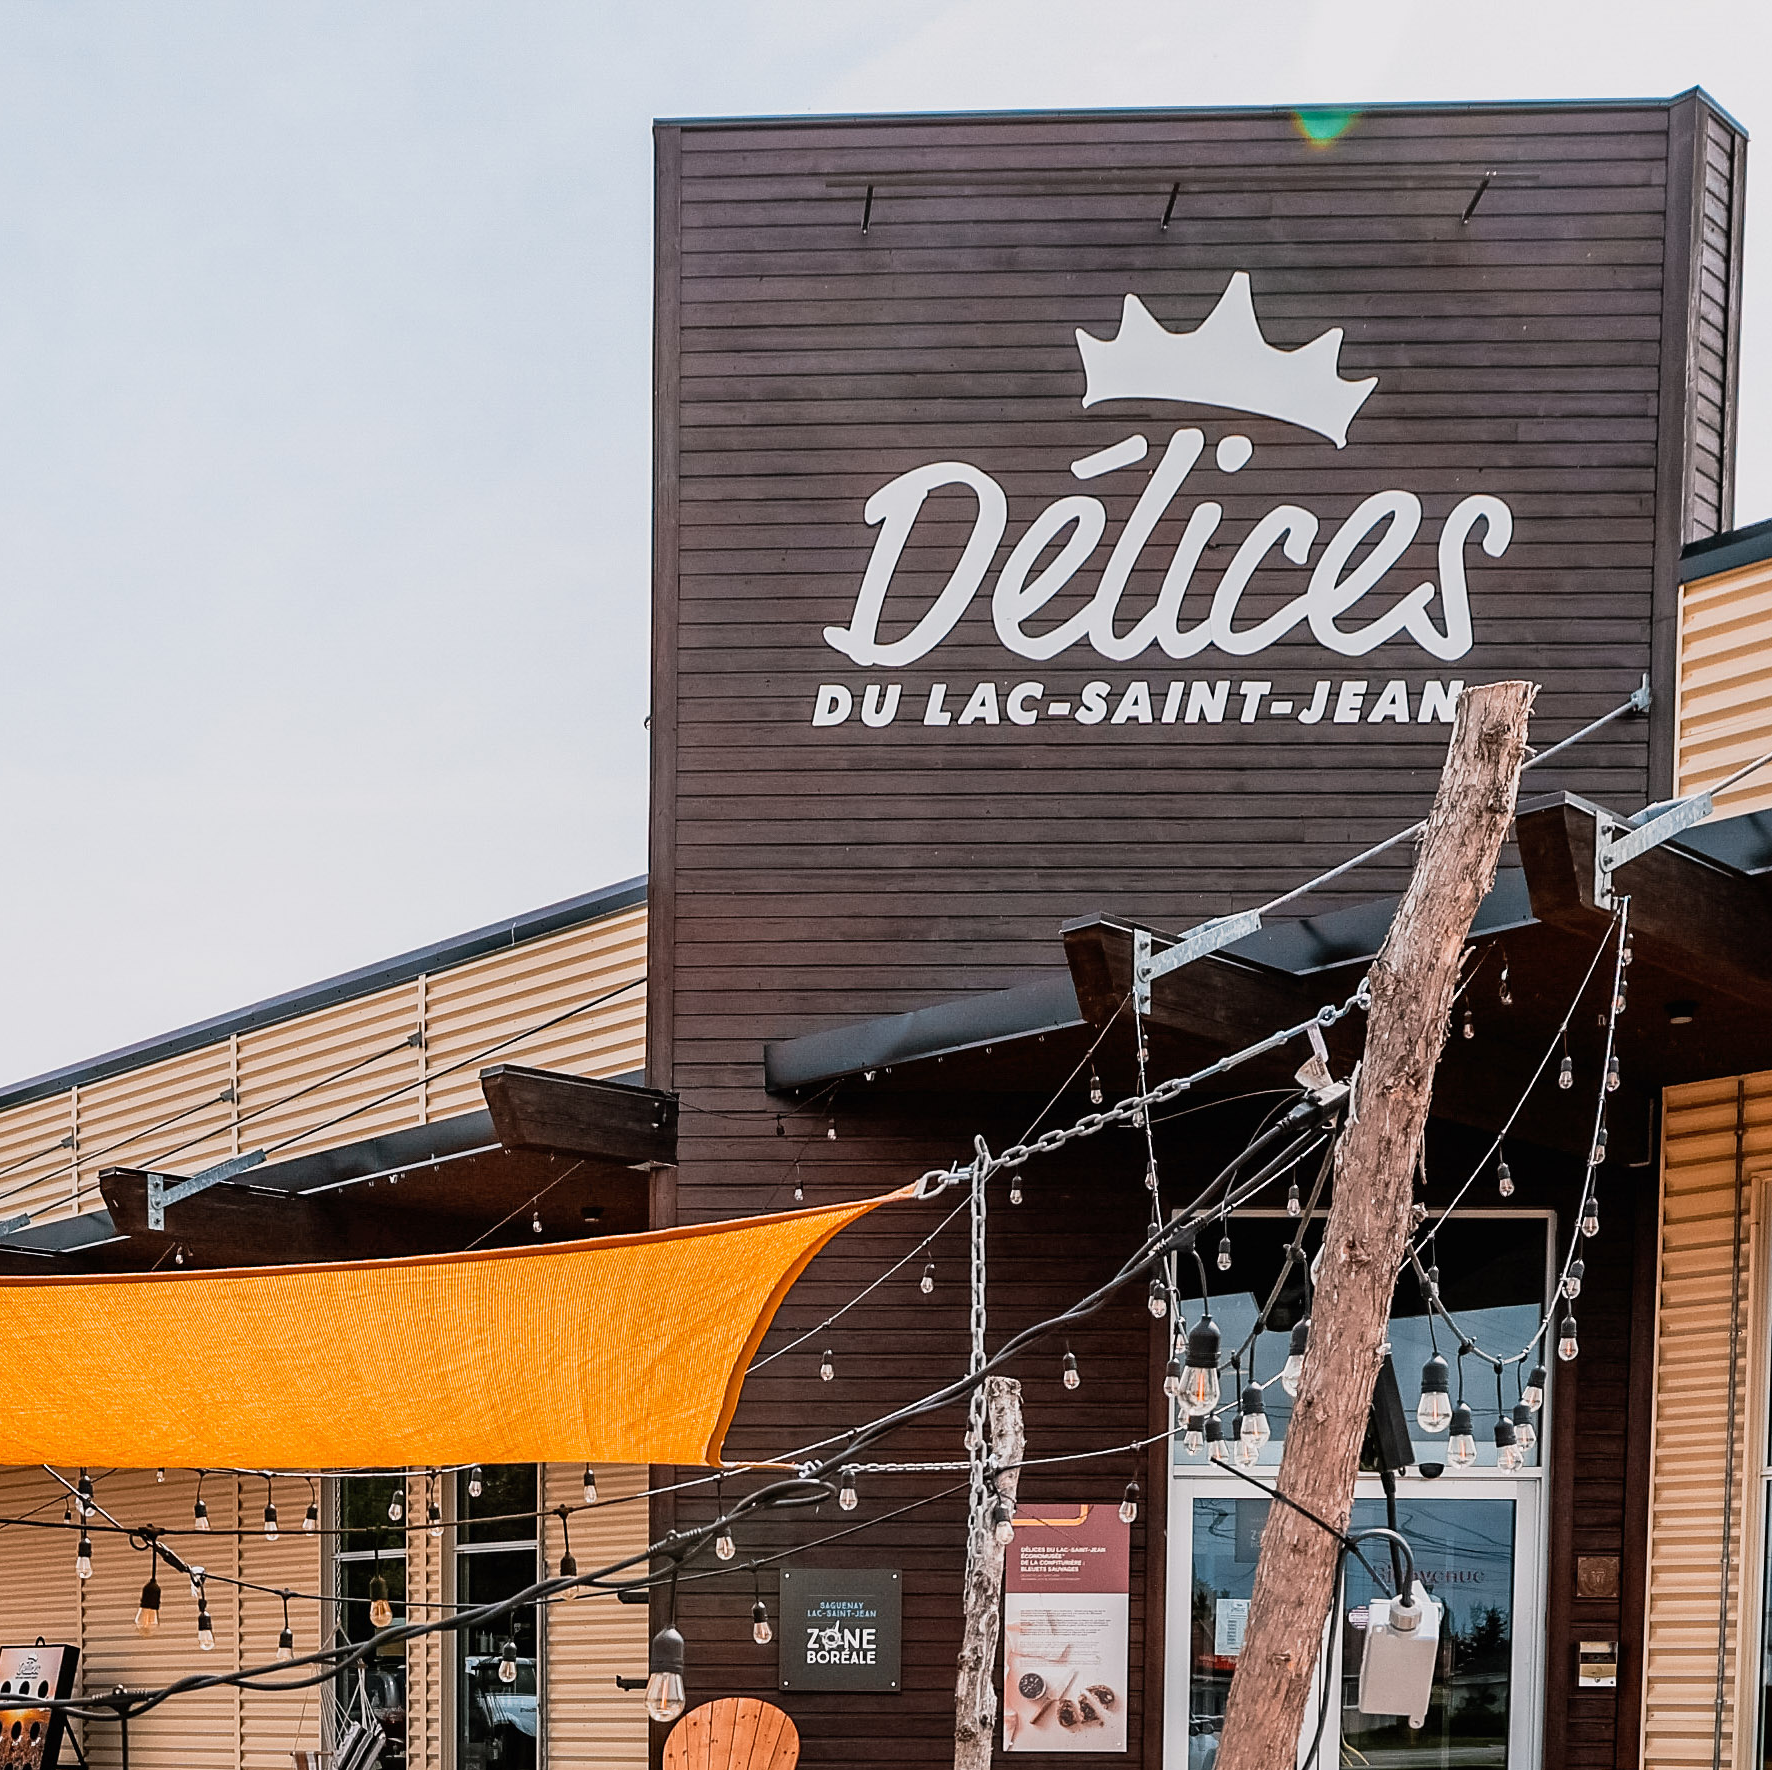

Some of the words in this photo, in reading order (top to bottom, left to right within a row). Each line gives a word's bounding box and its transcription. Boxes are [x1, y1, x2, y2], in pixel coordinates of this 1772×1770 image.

[823, 428, 1513, 667] Délices
[811, 683, 903, 728] DU
[922, 680, 1465, 727] LAC-SAINT-JEAN
[807, 1609, 877, 1618] LAC-SAINT-JEAN
[819, 1601, 864, 1610] SAGUENAY
[806, 1626, 877, 1650] ZONE
[806, 1649, 877, 1665] BORÉALE
